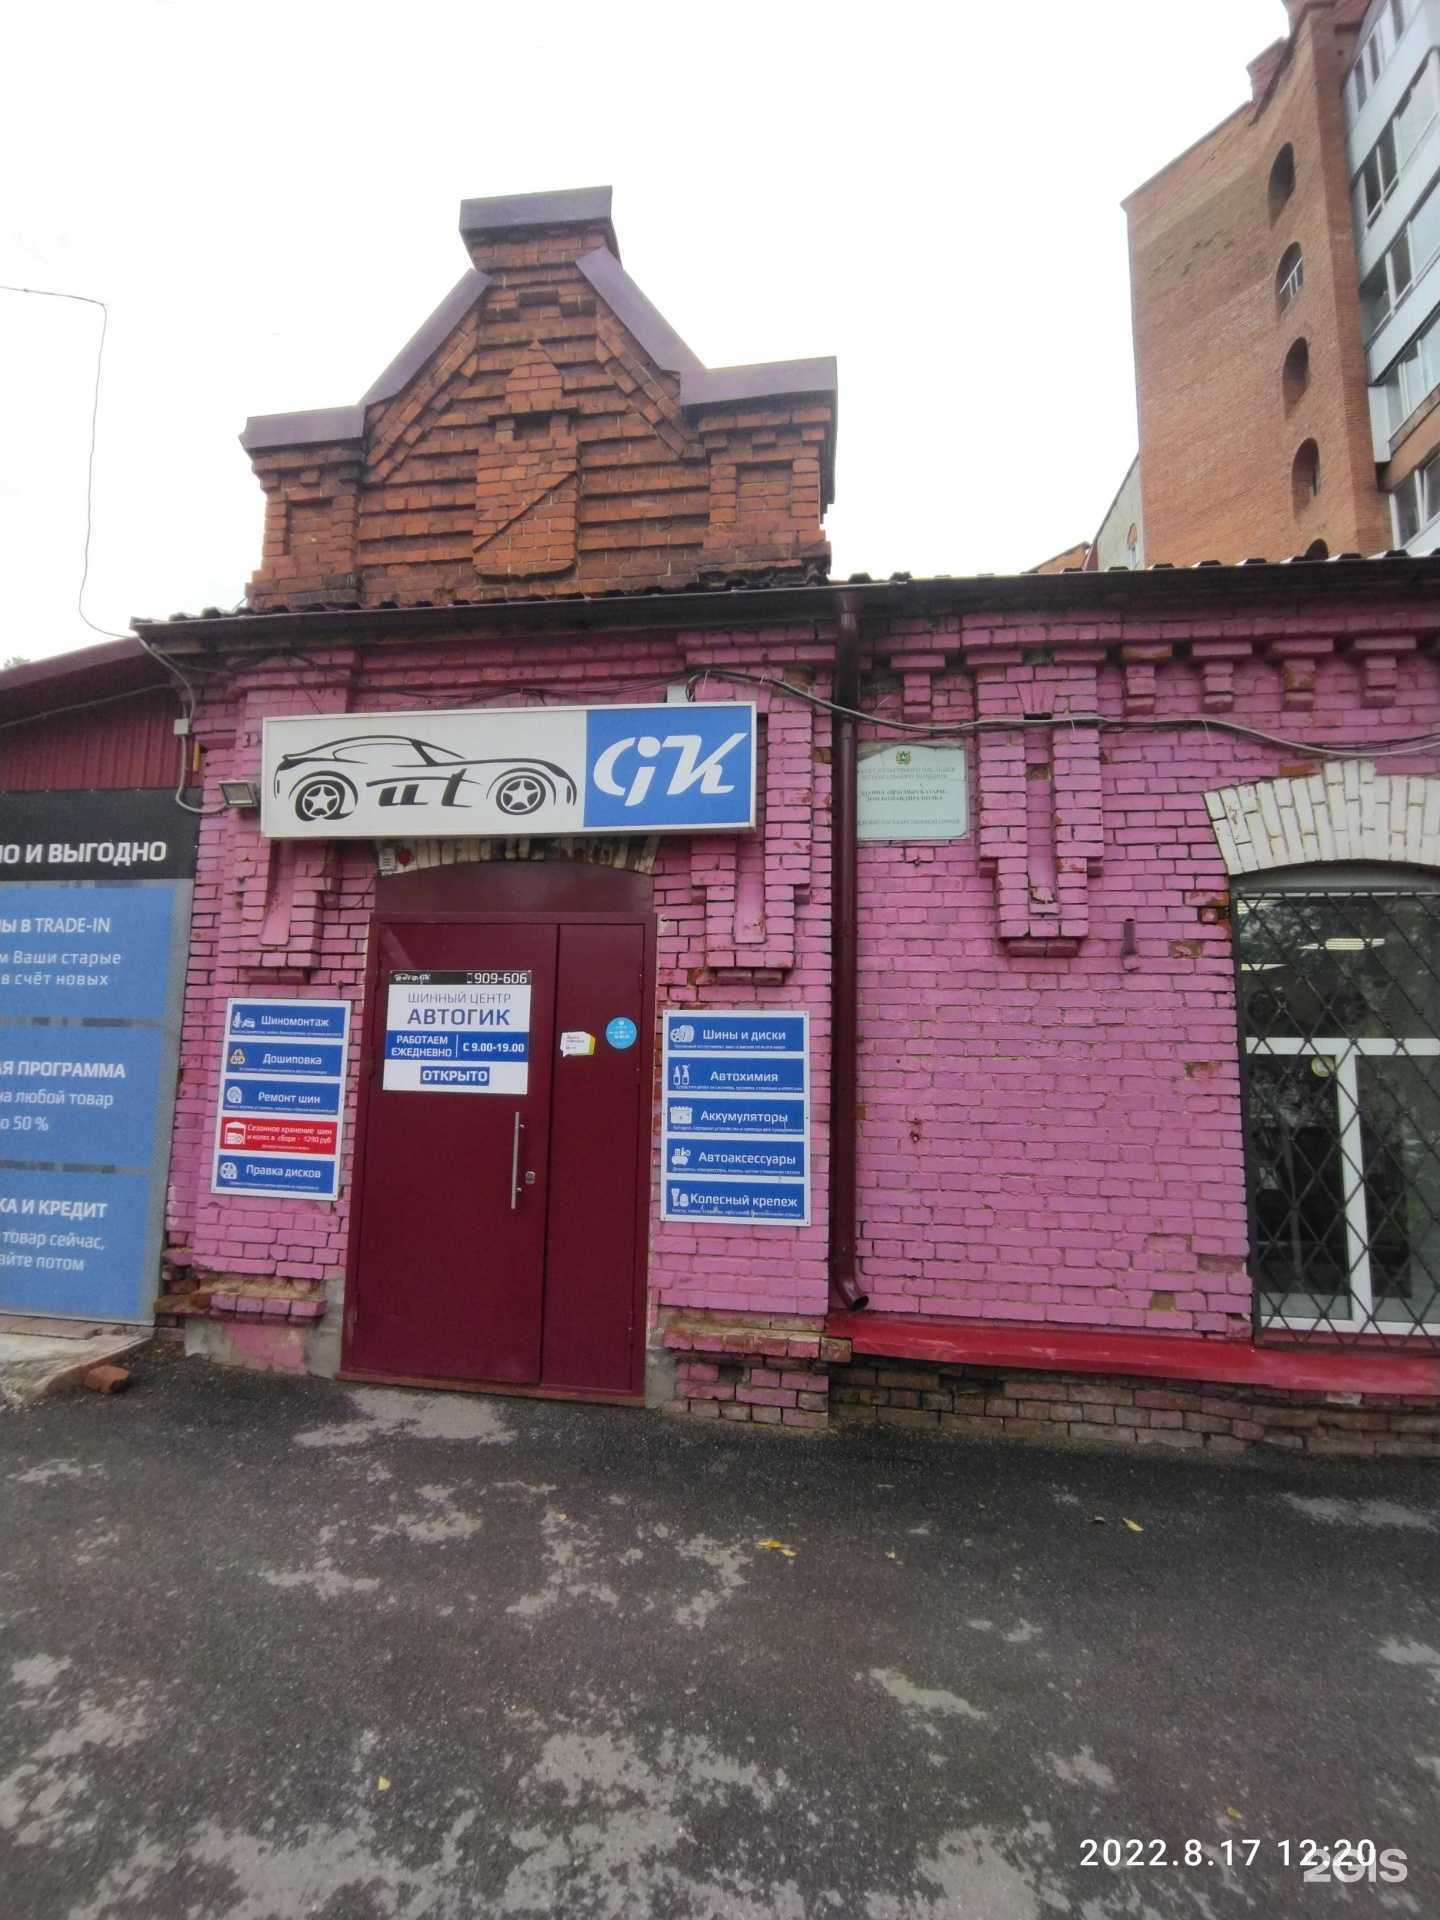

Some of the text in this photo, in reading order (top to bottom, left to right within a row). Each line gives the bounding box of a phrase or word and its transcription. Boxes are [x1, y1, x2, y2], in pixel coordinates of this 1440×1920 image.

[25, 844, 43, 863] И
[48, 841, 167, 866] ВЫГОДНО
[21, 919, 31, 932] В
[36, 917, 111, 933] TRADE-IN
[13, 950, 57, 964] Ваши
[62, 953, 121, 967] старые
[14, 972, 50, 985] счёт
[56, 975, 109, 986] новых
[474, 972, 528, 984] 909-606
[408, 991, 511, 1004] ШИННЫЙ ЦЕНТР
[261, 1015, 330, 1027] Шиномонтаж
[407, 1008, 511, 1025] АВТОГИК
[396, 1035, 448, 1045] РАБОТАЕМ
[703, 1029, 786, 1041] Шины и диски
[391, 1048, 452, 1057] ЕЖЕДНЕВНО
[471, 1043, 525, 1053] 9.00-19.00
[262, 1053, 322, 1065] Дошиповка
[17, 1061, 126, 1078] ПРОГРАММА
[422, 1070, 488, 1082] ОТКРЫТО
[710, 1071, 778, 1082] Автохимия
[16, 1089, 65, 1104] любой
[69, 1094, 113, 1109] товар
[258, 1091, 320, 1104] Ремонт шин
[13, 1116, 32, 1130] 50
[35, 1116, 49, 1131] %
[700, 1110, 788, 1124] Аккумуляторы
[699, 1152, 796, 1167] Автоаксессуары
[246, 1165, 321, 1179] Правка дисков
[690, 1193, 797, 1209] Колесный крепеж
[21, 1199, 34, 1214] И
[38, 1199, 108, 1220] КРЕДИТ
[2, 1231, 46, 1248] товар
[36, 1256, 84, 1271] потом
